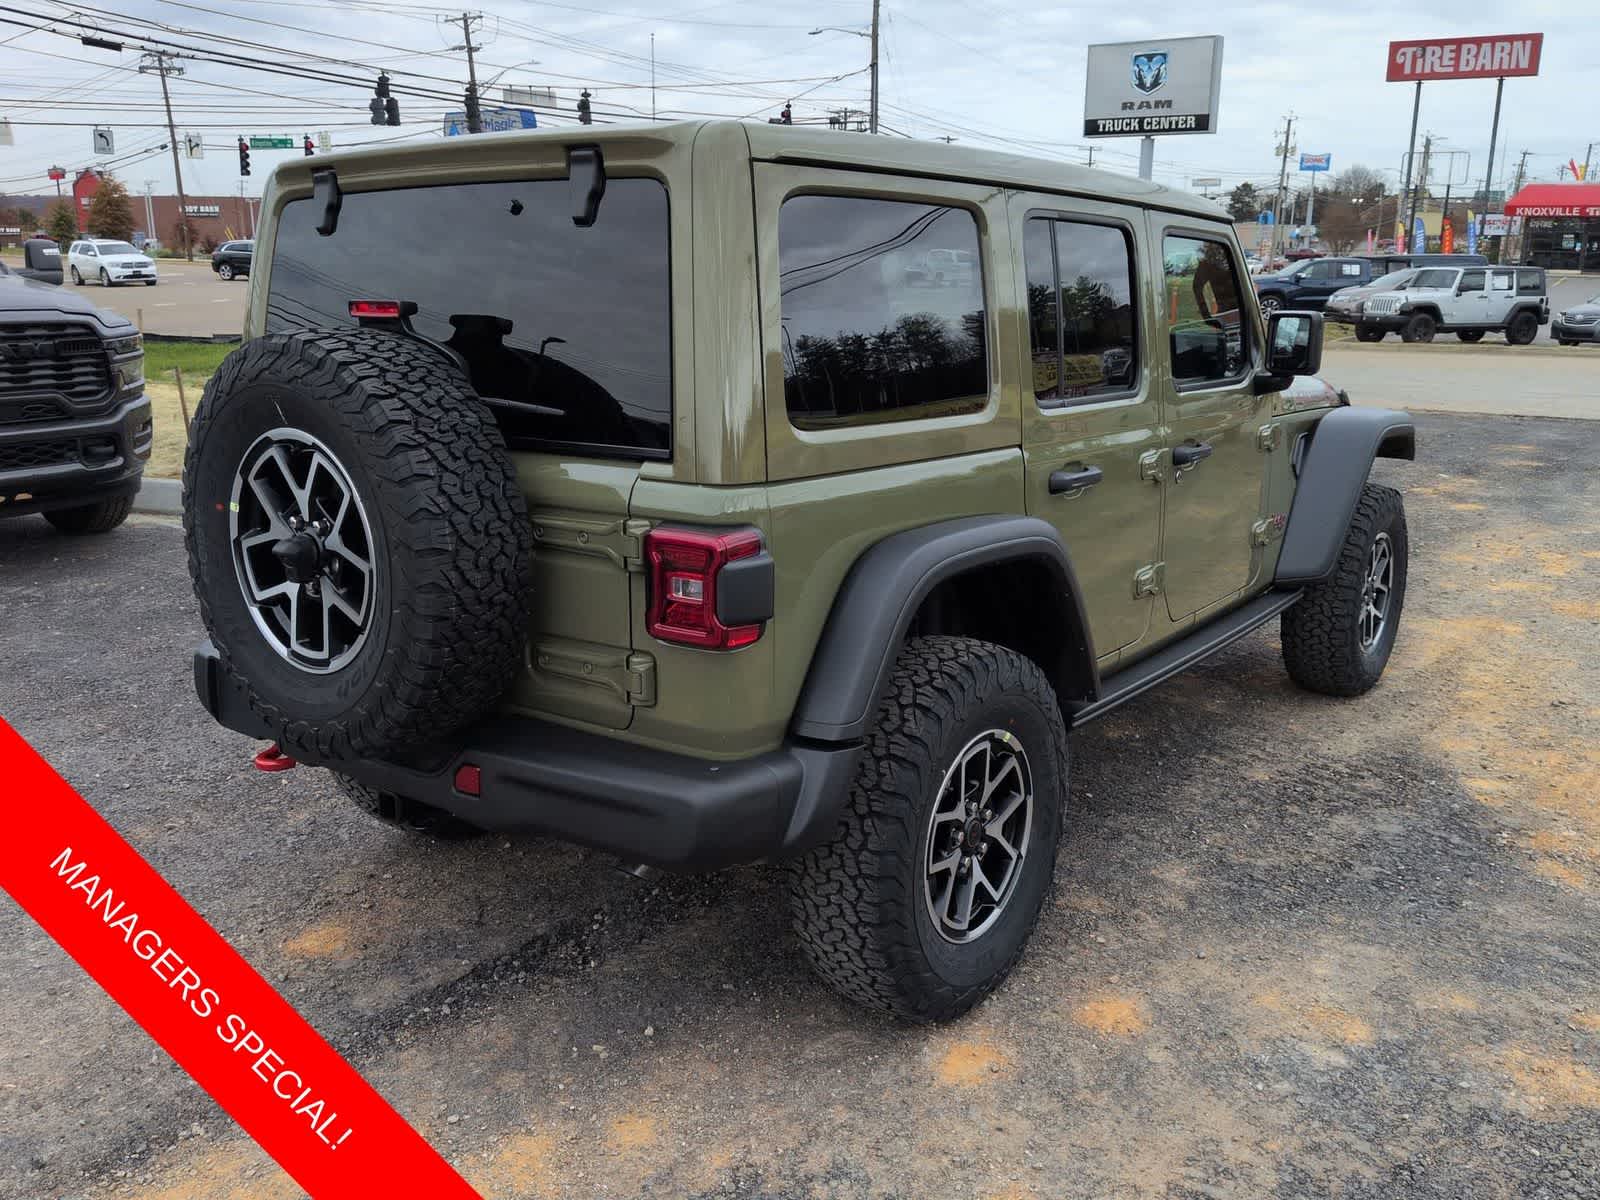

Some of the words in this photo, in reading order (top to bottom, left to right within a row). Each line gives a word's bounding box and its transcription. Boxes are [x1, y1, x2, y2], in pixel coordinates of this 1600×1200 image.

[1458, 39, 1532, 72] BARN
[1120, 99, 1173, 111] RAM
[1097, 118, 1140, 132] TRUCK
[1143, 115, 1196, 130] CENTER
[1516, 207, 1581, 216] KNOXVILLE
